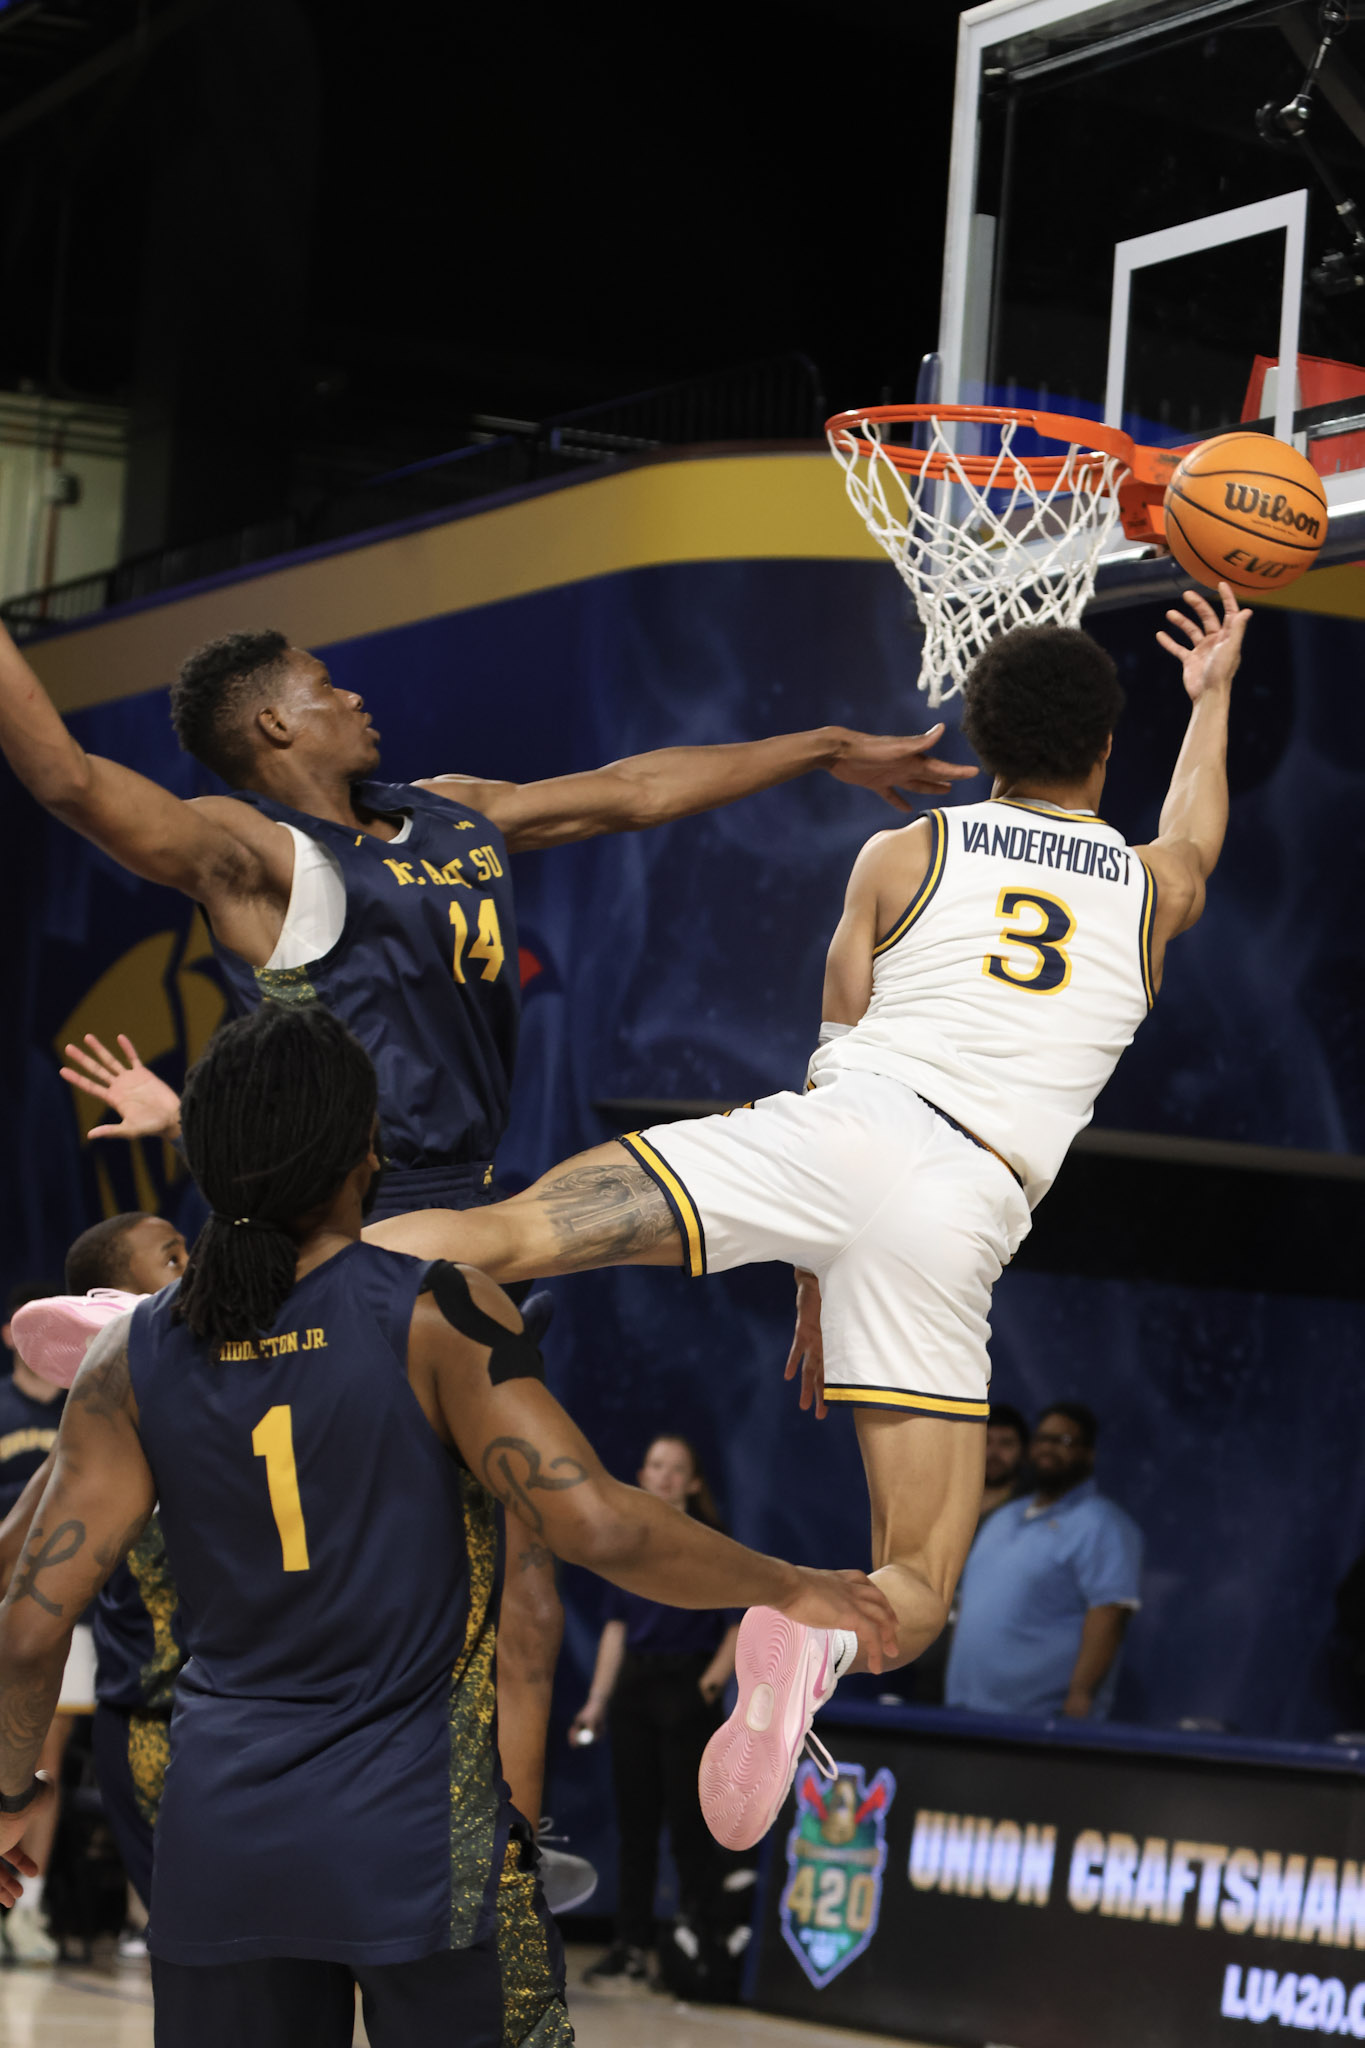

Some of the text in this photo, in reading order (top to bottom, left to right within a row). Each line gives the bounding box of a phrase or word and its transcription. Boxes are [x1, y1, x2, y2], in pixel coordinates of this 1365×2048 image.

[1224, 481, 1320, 540] Wilson
[962, 821, 1131, 886] VANDERHORST
[449, 899, 504, 984] 14
[981, 886, 1077, 996] 3
[302, 1328, 328, 1350] JR.
[251, 1404, 310, 1572] 1
[908, 1809, 1058, 1908] UNION
[787, 1865, 875, 1932] 420
